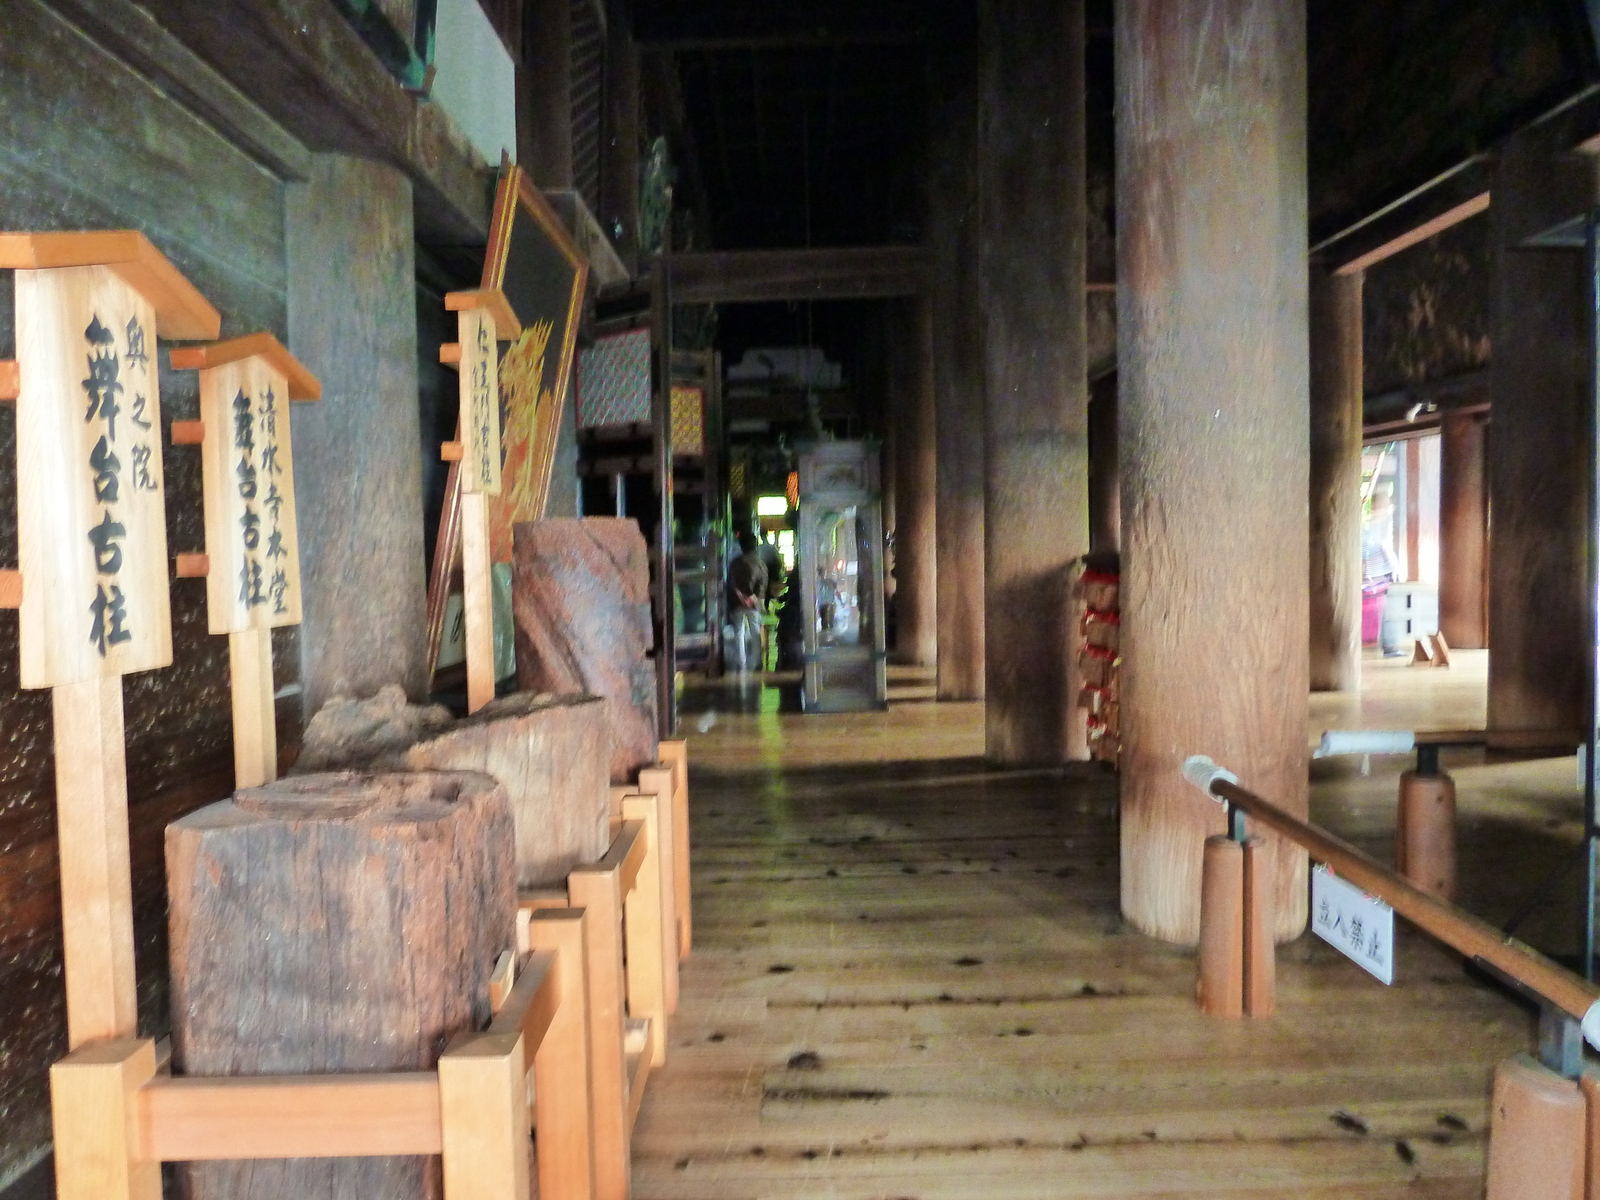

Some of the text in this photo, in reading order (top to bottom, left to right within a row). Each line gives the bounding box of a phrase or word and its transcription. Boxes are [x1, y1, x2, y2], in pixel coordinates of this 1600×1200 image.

[81, 313, 134, 659] 舞台古柱
[231, 387, 270, 612] 舞台古柱
[258, 383, 289, 614] 清水寺本堂
